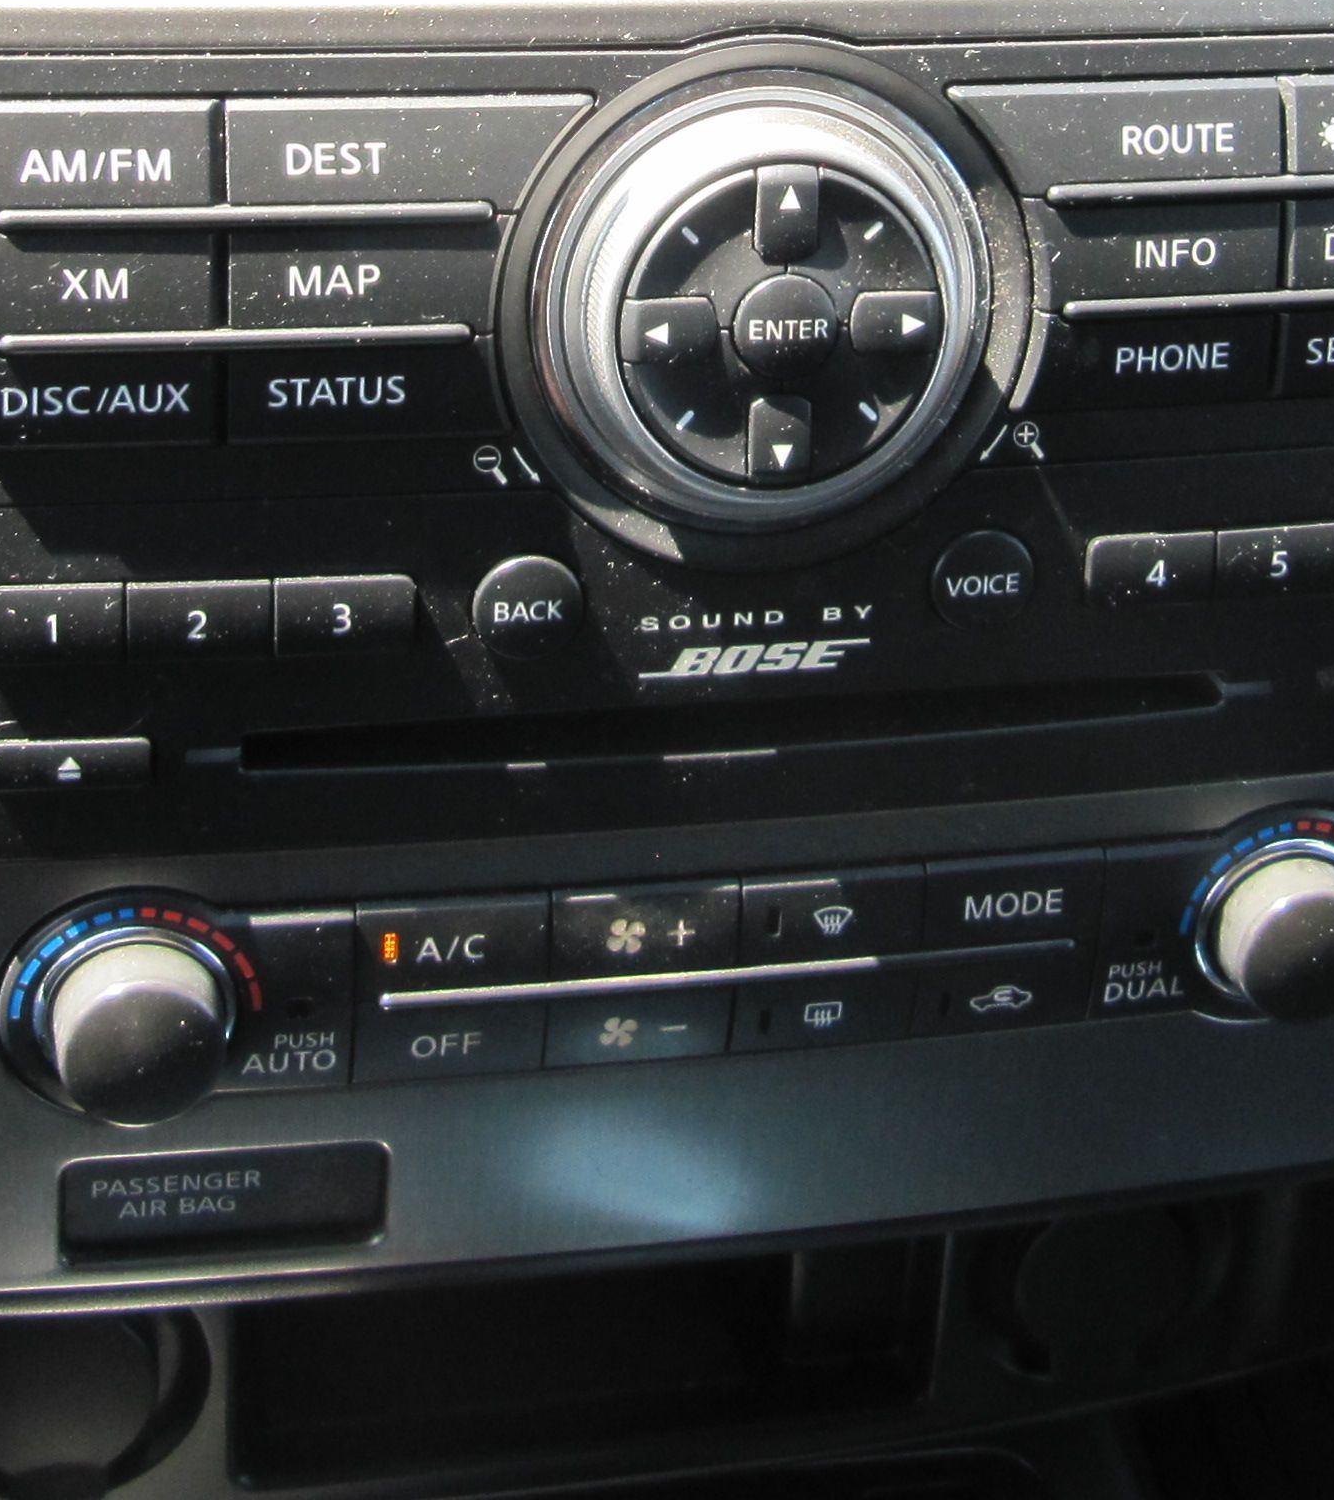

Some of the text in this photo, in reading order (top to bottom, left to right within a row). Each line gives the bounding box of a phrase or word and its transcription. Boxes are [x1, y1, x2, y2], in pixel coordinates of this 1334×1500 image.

[1121, 122, 1235, 157] ROUTE
[19, 148, 173, 184] AM/FM
[284, 141, 387, 176] DEST
[1134, 237, 1217, 269] INFO
[61, 267, 130, 301] XM
[288, 263, 381, 297] MAP
[748, 318, 829, 342] ENTER
[1115, 341, 1231, 375] PHONE
[1, 382, 191, 418] DISC/AUX
[267, 374, 406, 409] STATUS
[1145, 559, 1167, 588] 4
[1269, 550, 1289, 579] 5
[946, 572, 1020, 598] VOICE
[186, 610, 208, 641] 2
[332, 603, 352, 634] 3
[493, 599, 563, 624] BACK
[640, 603, 874, 632] SOUND BY
[46, 614, 59, 644] 1
[639, 638, 870, 679] BOSE
[963, 888, 1064, 922] MODE
[415, 933, 488, 965] A/C
[1107, 960, 1163, 980] PUSH
[1103, 974, 1185, 1003] DUAL
[274, 1031, 336, 1050] PUSH
[410, 1031, 484, 1060] OFF
[241, 1050, 337, 1075] AUTO
[91, 1169, 262, 1199] PASSENGER
[117, 1196, 238, 1220] AIR BAG
